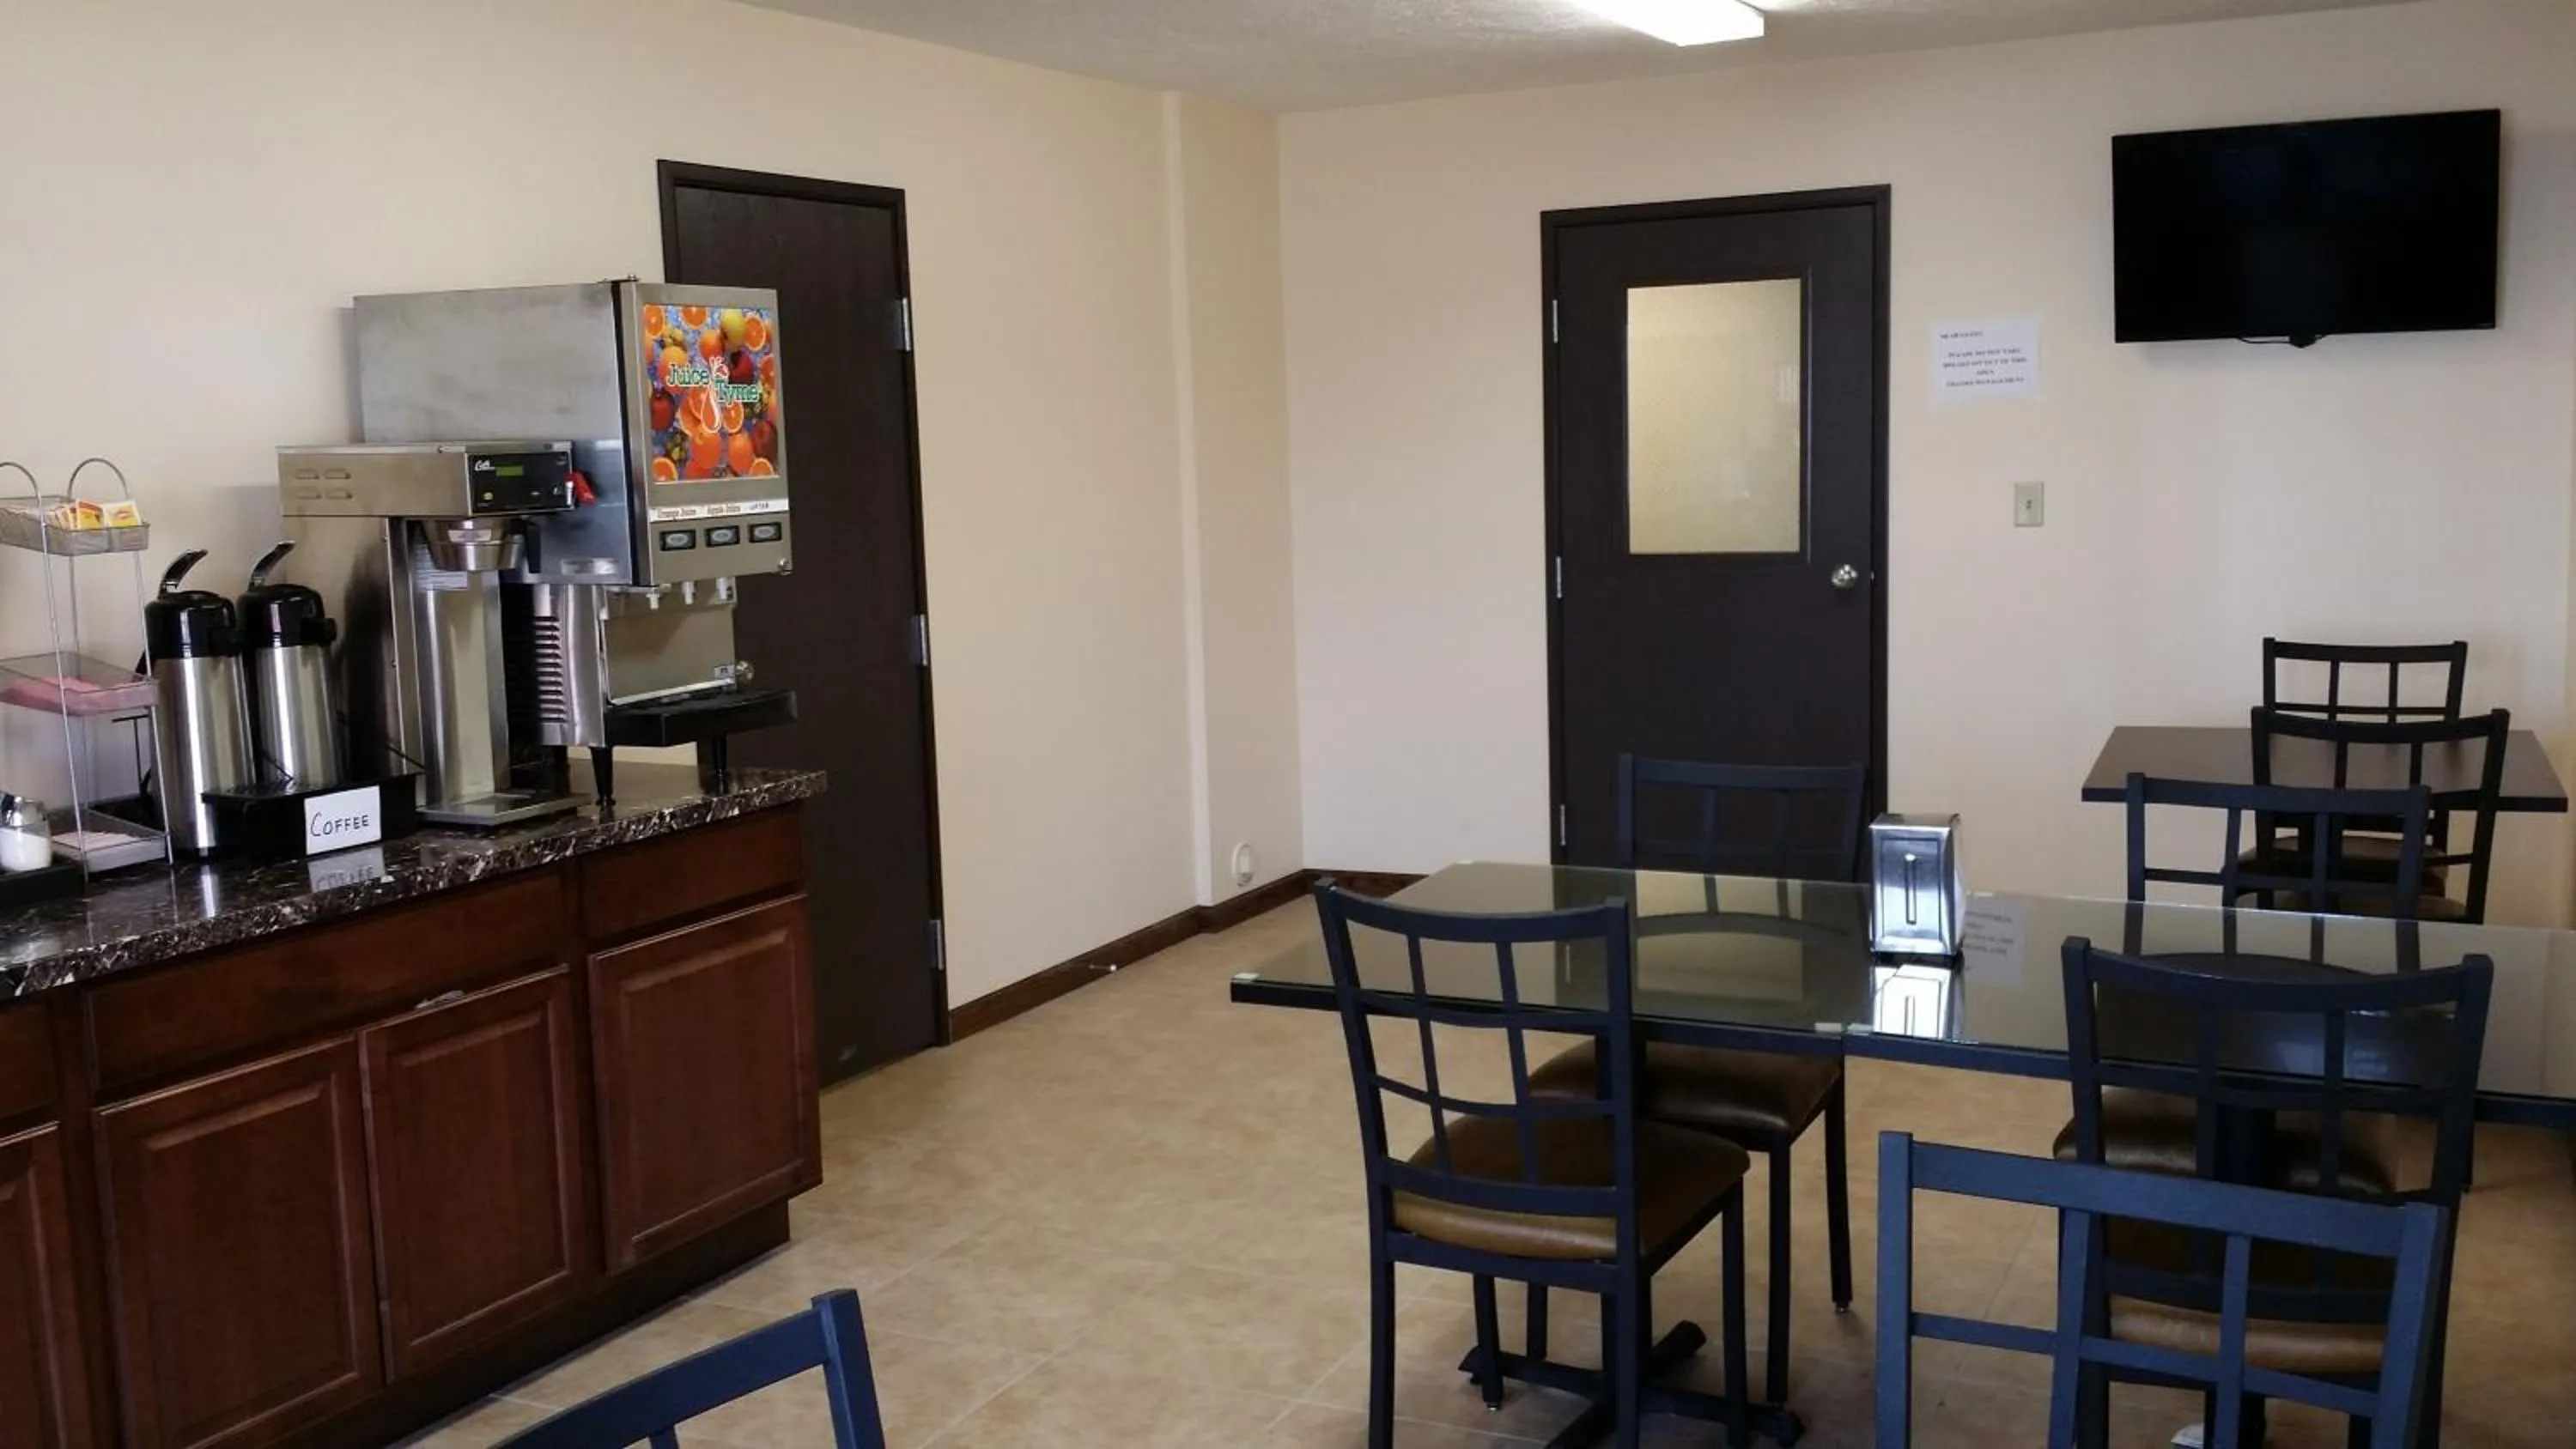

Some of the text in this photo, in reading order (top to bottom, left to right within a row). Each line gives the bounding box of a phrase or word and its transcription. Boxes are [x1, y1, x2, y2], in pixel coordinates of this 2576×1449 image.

[669, 362, 710, 385] Juice
[714, 377, 758, 404] Tyme
[310, 811, 369, 837] COFFEE
